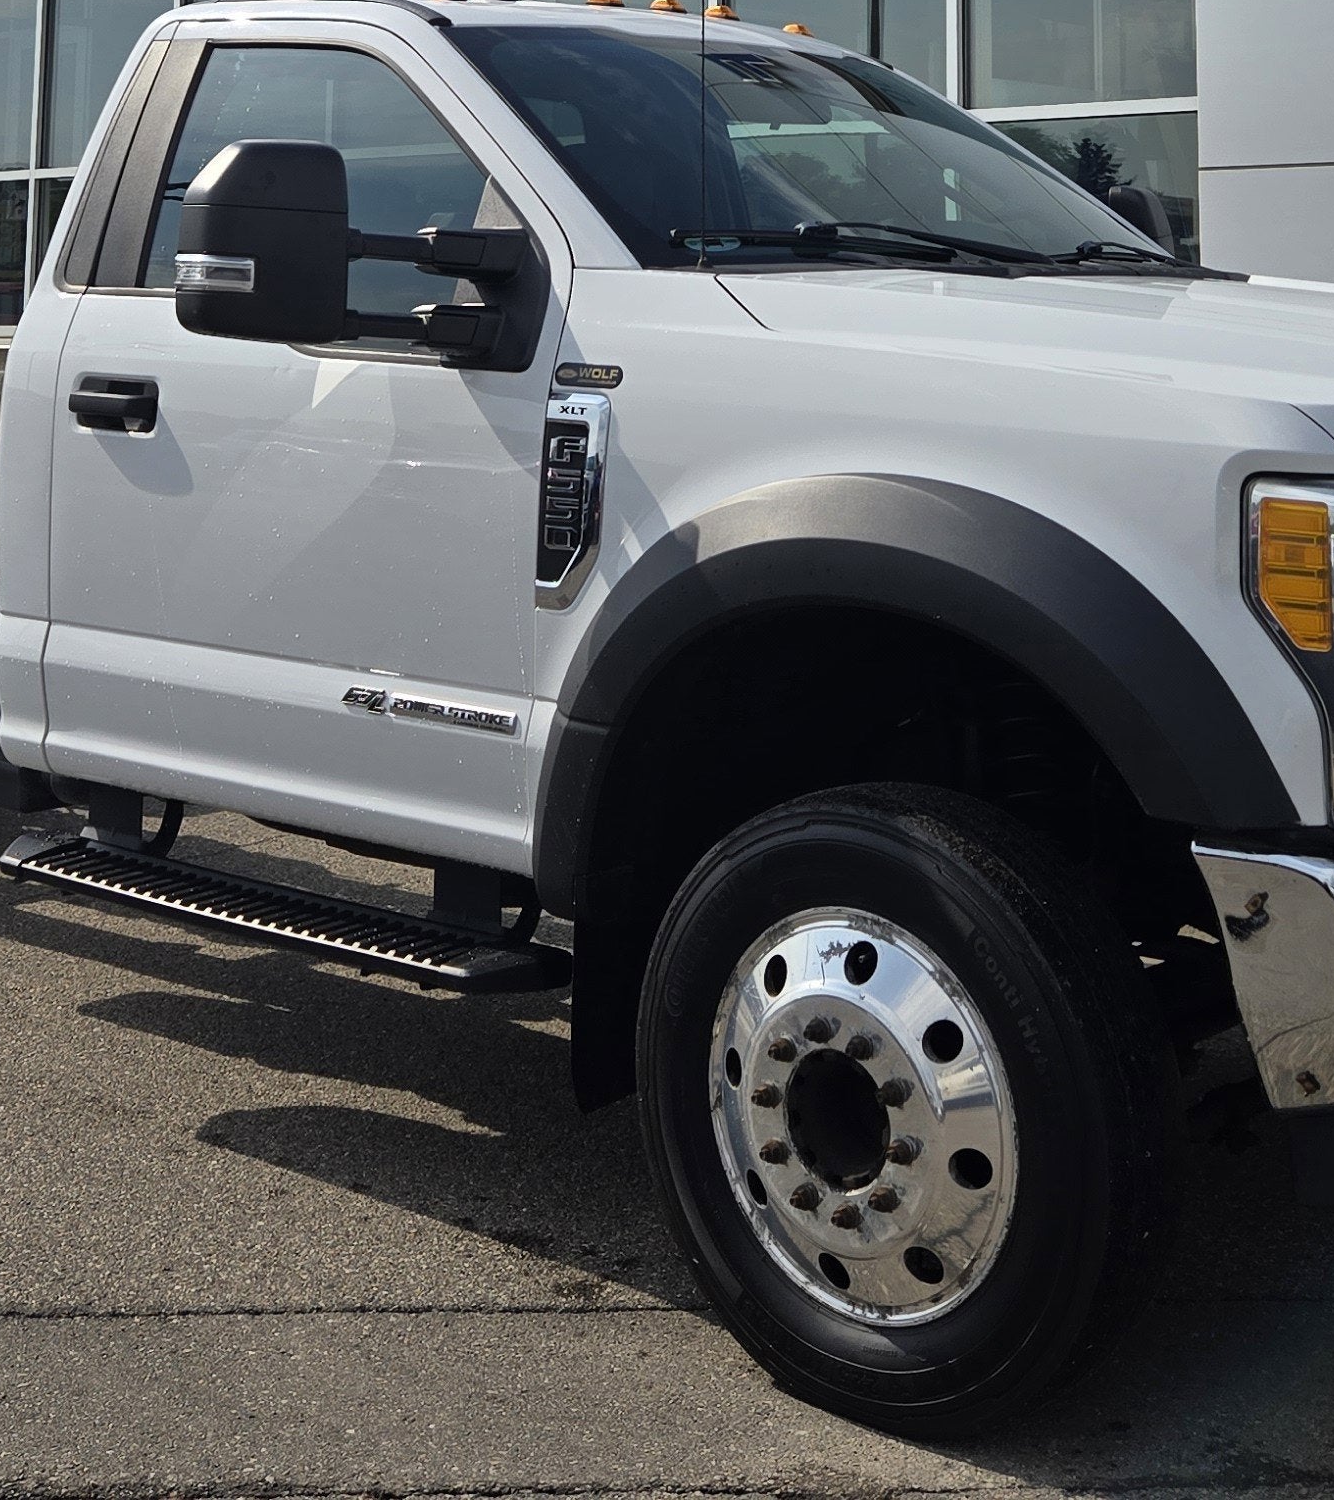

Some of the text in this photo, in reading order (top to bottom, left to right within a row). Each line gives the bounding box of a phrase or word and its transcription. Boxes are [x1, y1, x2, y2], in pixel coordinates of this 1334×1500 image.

[579, 367, 619, 380] WOLF
[559, 405, 587, 416] XLT
[448, 707, 512, 726] STROKE
